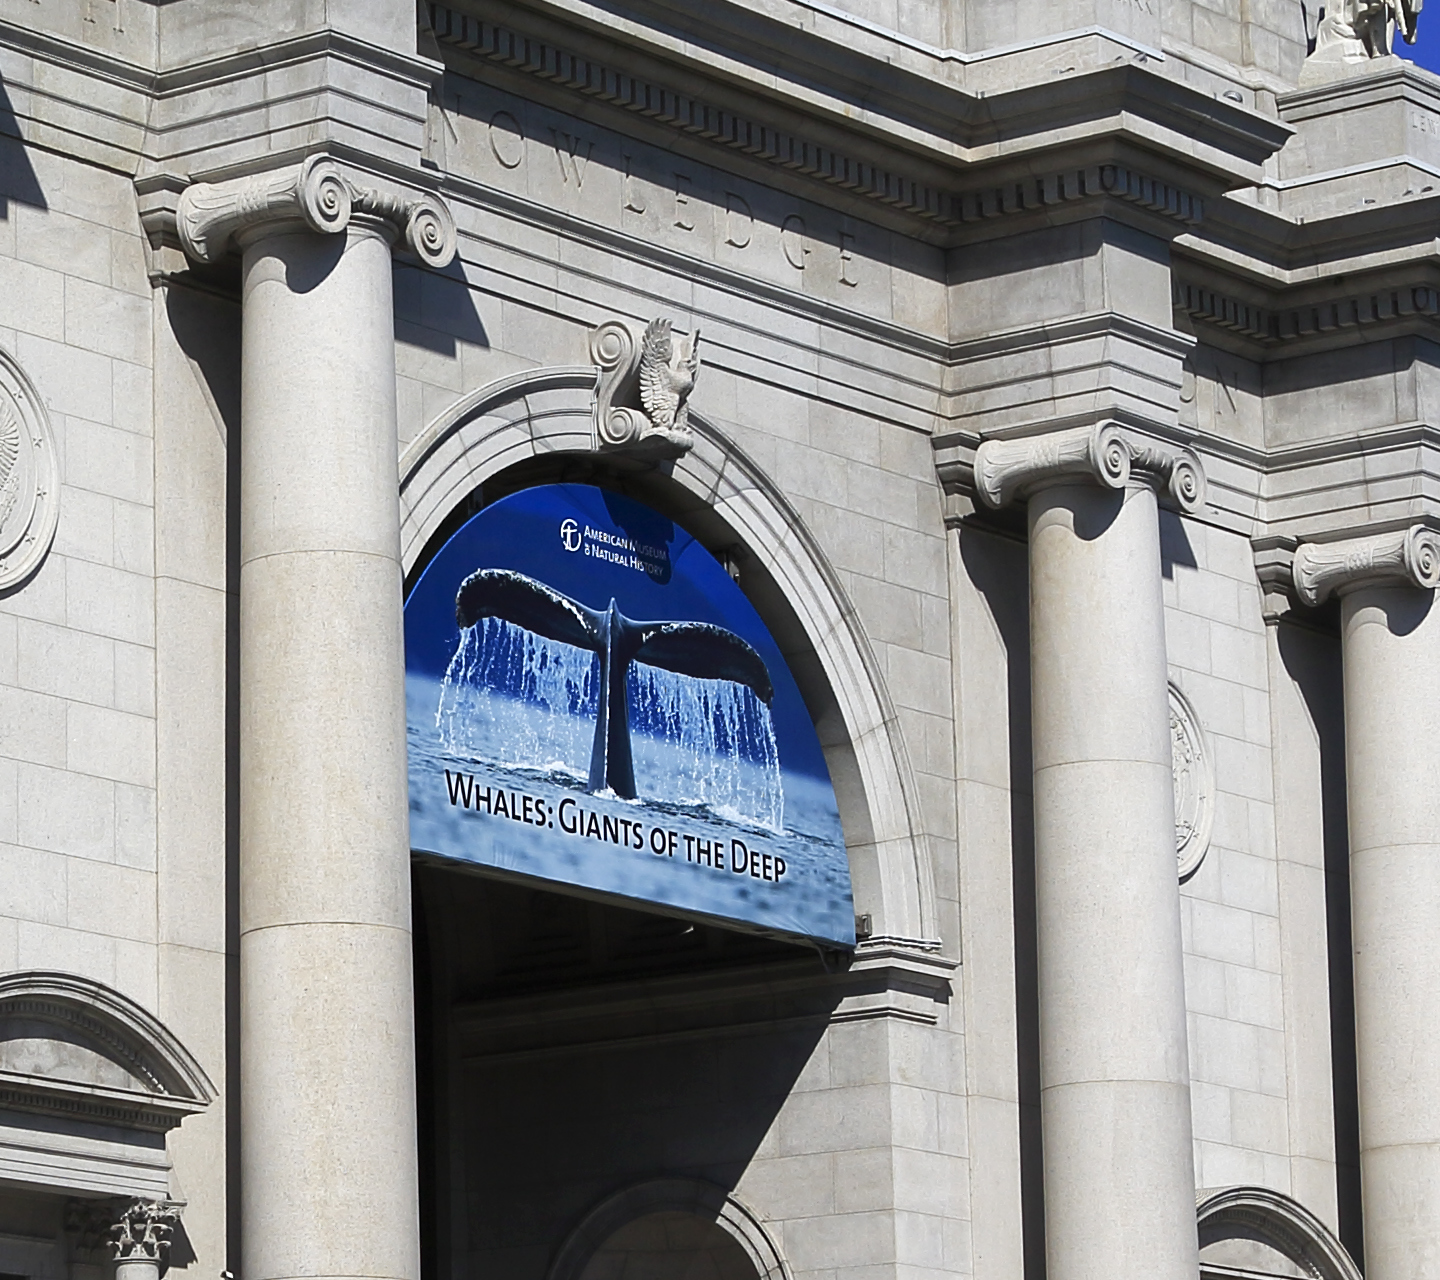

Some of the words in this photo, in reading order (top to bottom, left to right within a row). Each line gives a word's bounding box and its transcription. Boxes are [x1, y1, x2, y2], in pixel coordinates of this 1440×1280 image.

[427, 92, 858, 289] NOWLEDGE
[583, 524, 629, 550] AMERICAN
[629, 538, 667, 561] MUSEUM
[591, 543, 629, 568] NATURAL
[630, 555, 663, 577] HISTORY
[445, 769, 553, 829] WHALES:
[559, 798, 644, 850] GIANTS
[650, 827, 678, 858] OF
[683, 834, 725, 870] THE
[731, 838, 787, 883] DEEP
